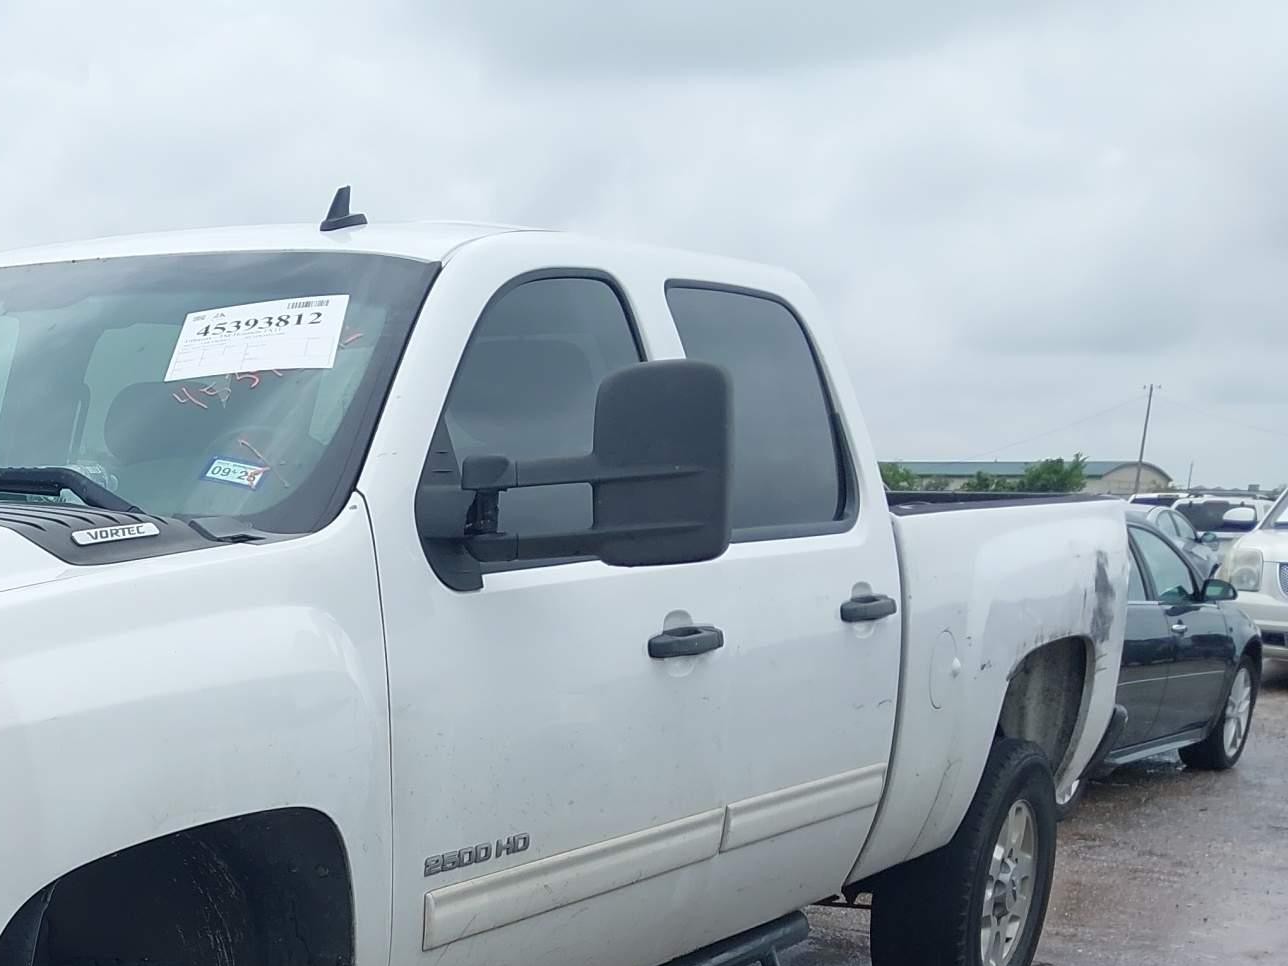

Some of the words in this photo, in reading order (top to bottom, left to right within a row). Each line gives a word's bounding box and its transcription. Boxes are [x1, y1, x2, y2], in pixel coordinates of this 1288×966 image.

[196, 311, 323, 336] 45393812
[211, 465, 231, 477] 09
[87, 525, 145, 541] VORTEC
[425, 843, 492, 877] 2500
[496, 833, 530, 859] HD
